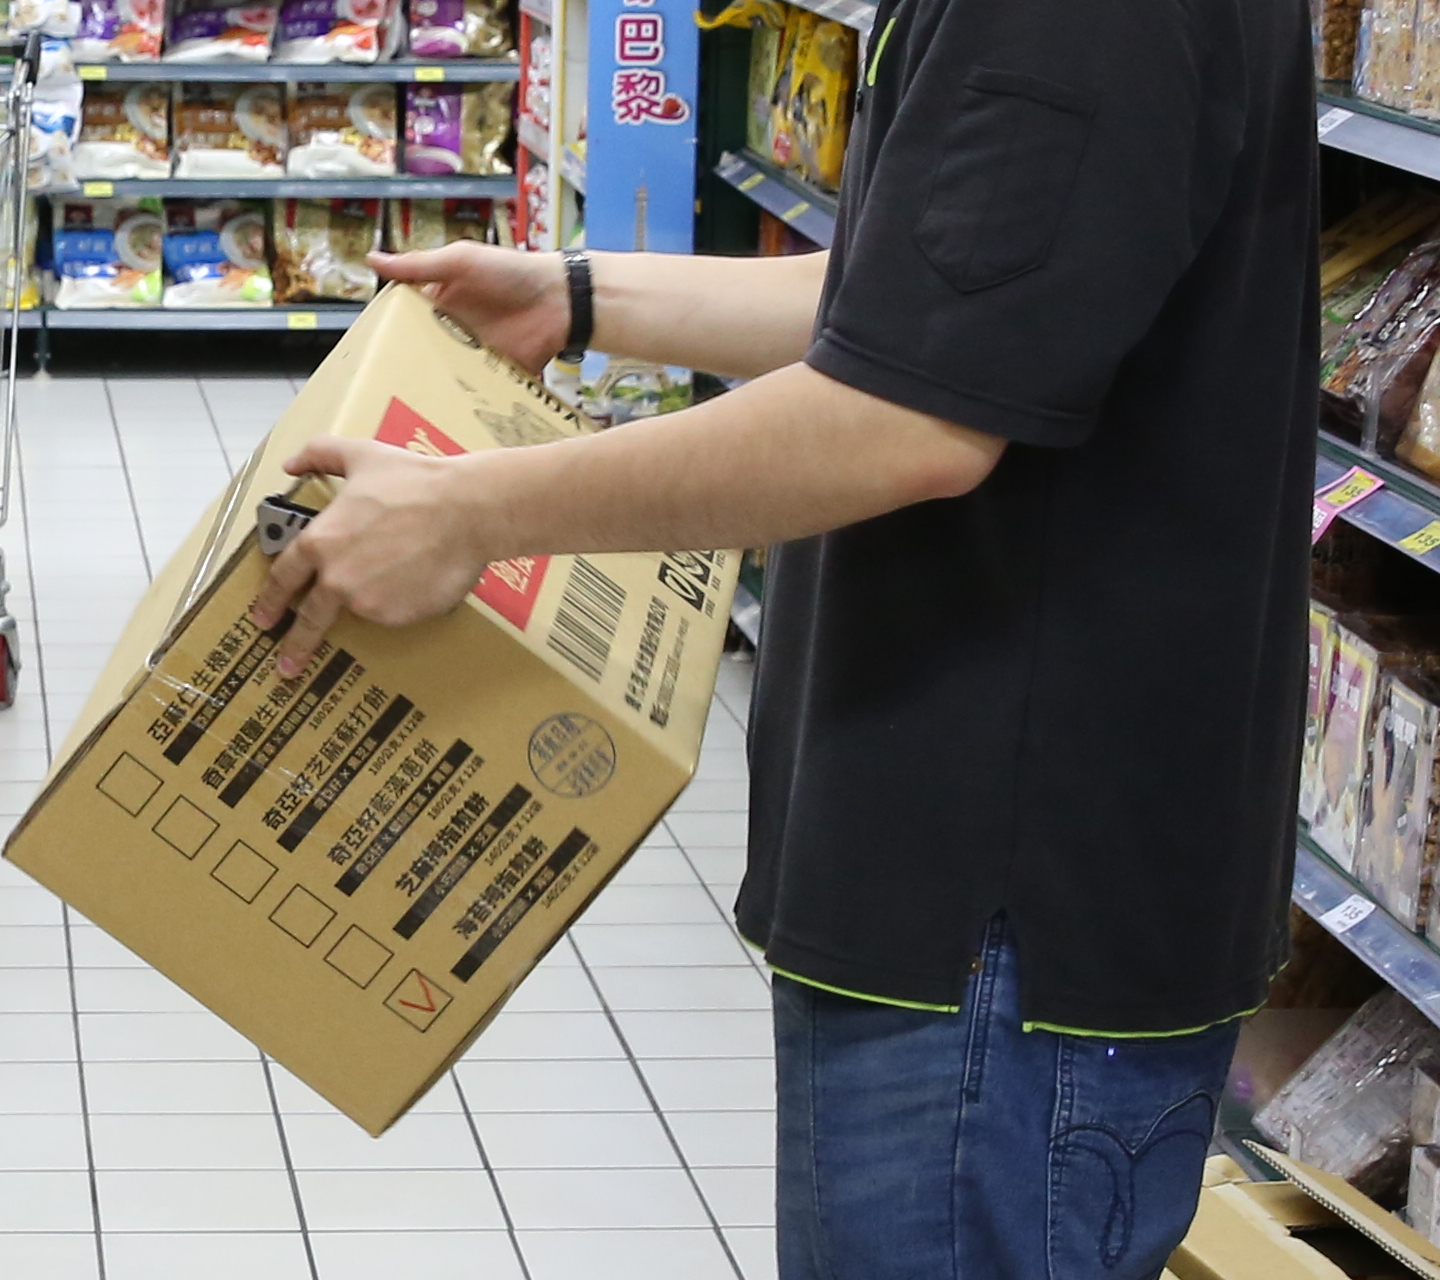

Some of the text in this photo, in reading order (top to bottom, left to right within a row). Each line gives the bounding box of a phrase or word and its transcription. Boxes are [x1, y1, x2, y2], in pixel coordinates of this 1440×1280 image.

[613, 13, 672, 126] 巴黎
[1415, 531, 1440, 550] 135
[1340, 901, 1364, 924] 135
